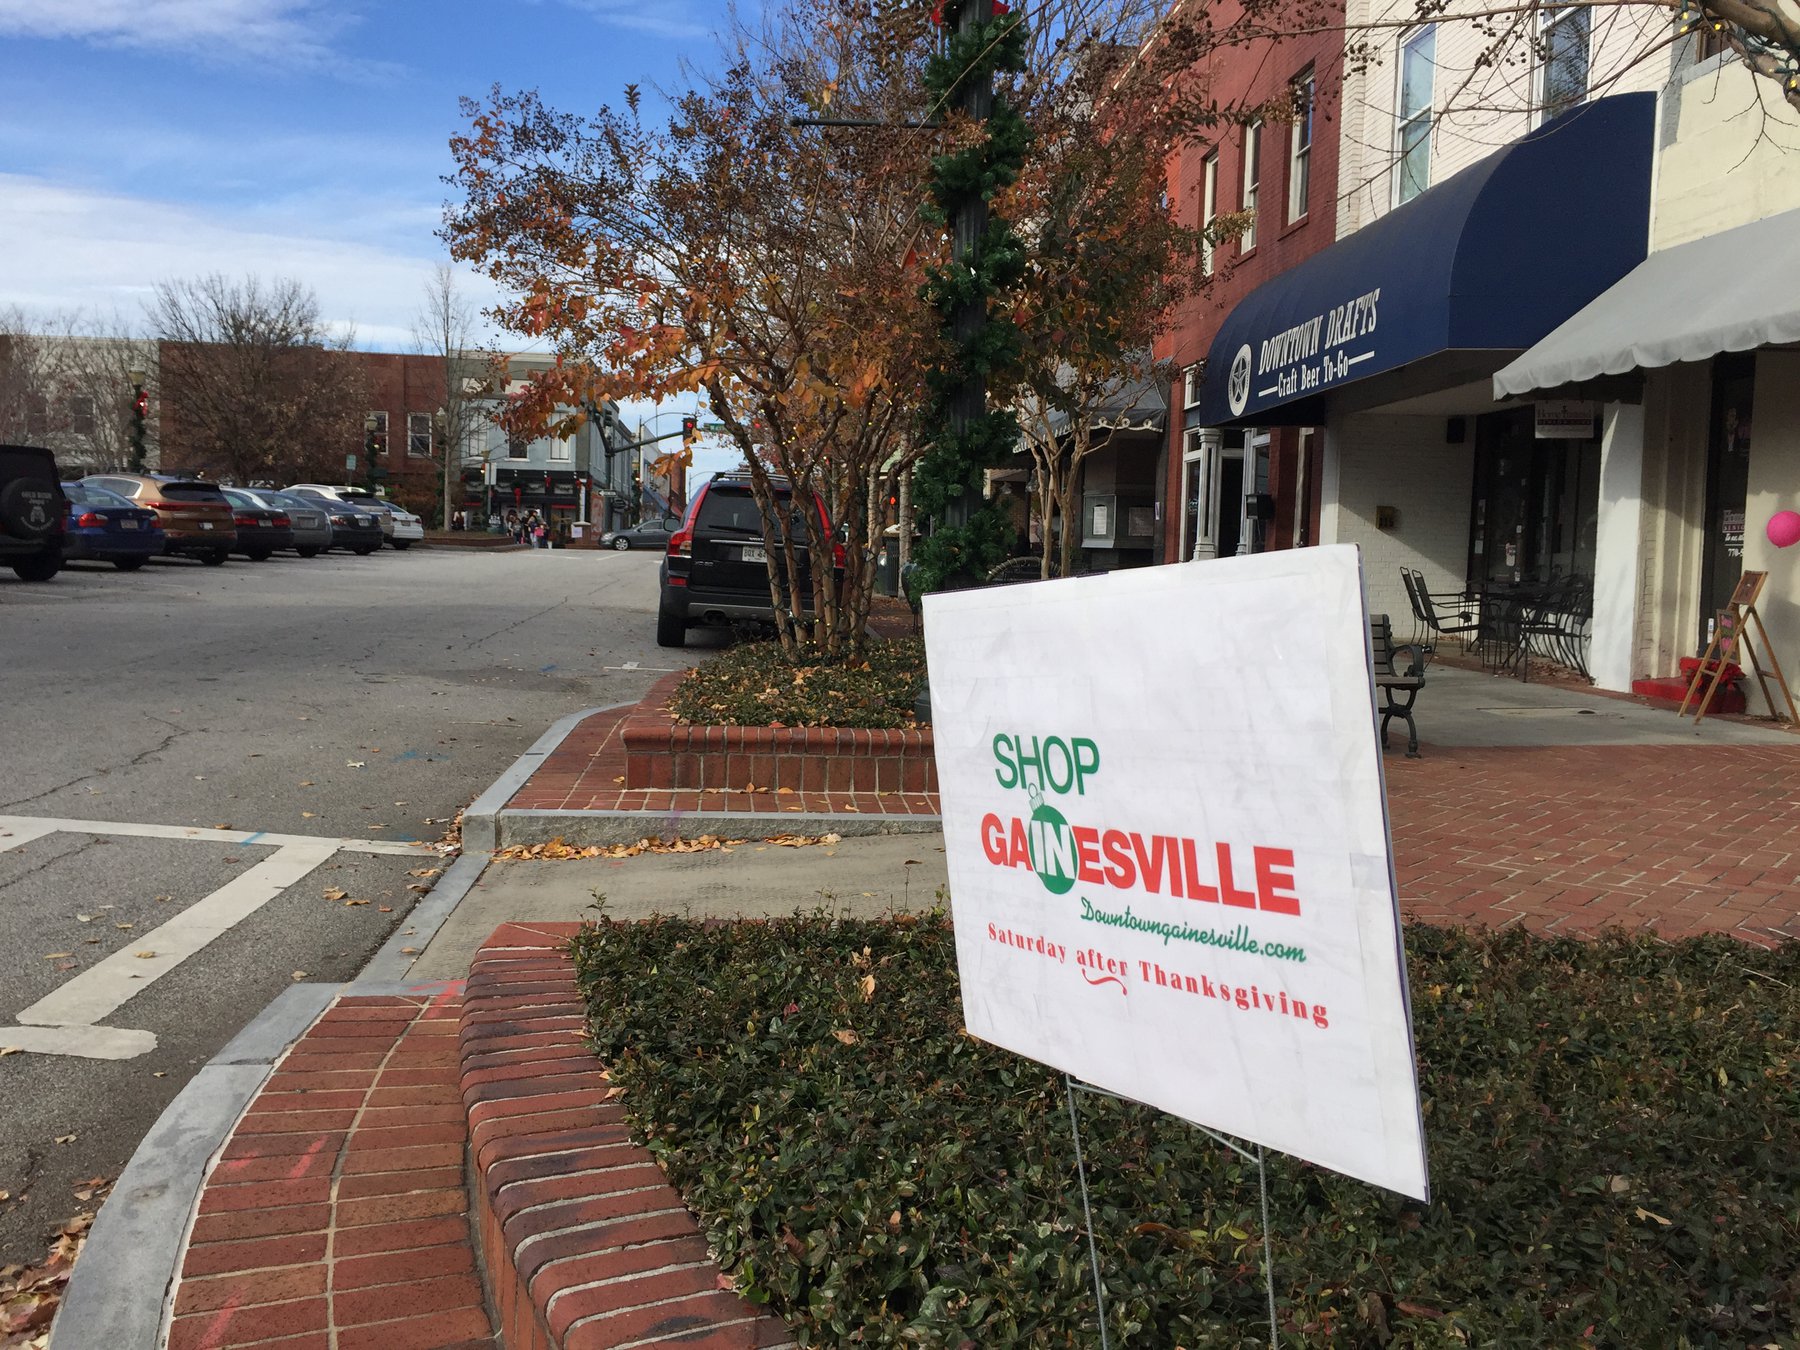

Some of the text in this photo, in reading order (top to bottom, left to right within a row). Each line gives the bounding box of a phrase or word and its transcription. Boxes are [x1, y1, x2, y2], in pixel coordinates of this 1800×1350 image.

[1258, 287, 1381, 376] DOWNTOWN DRAFTS
[1278, 349, 1349, 398] Craft Beer To-Go
[993, 733, 1100, 796] SHOP
[981, 812, 1301, 917] GAINESVILLE
[1080, 896, 1307, 963] Downtowngainesville.com
[988, 922, 1329, 1029] Saturday after Thanksgiving
